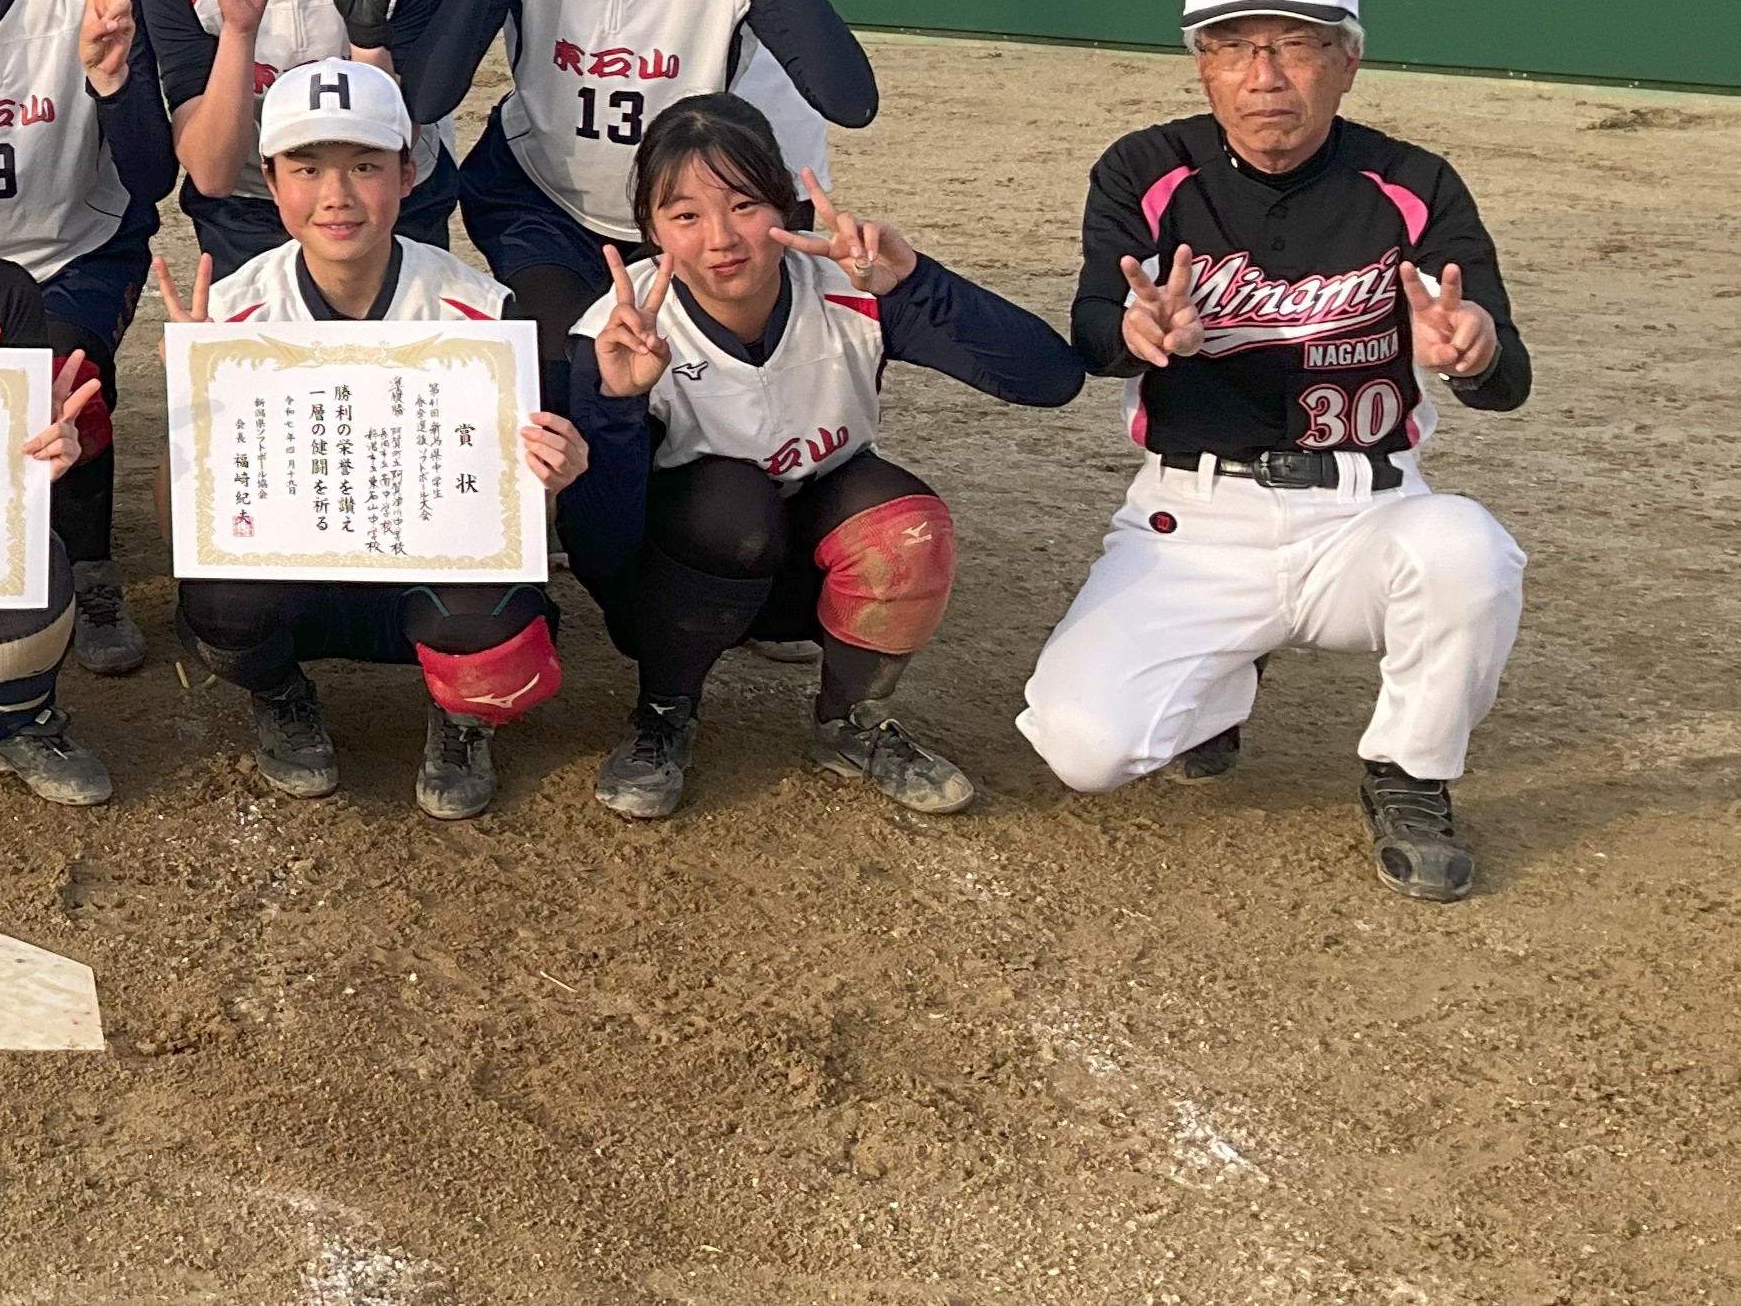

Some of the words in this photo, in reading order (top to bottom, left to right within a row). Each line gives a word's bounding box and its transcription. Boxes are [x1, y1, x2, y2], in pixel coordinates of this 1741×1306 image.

[309, 73, 351, 110] H
[576, 86, 644, 145] 13
[1190, 248, 1399, 325] Minami
[1309, 332, 1398, 368] NAGAOKA
[1296, 379, 1403, 450] 30
[309, 389, 329, 531] 一層の健闘を祈る
[454, 423, 479, 494] 賞状
